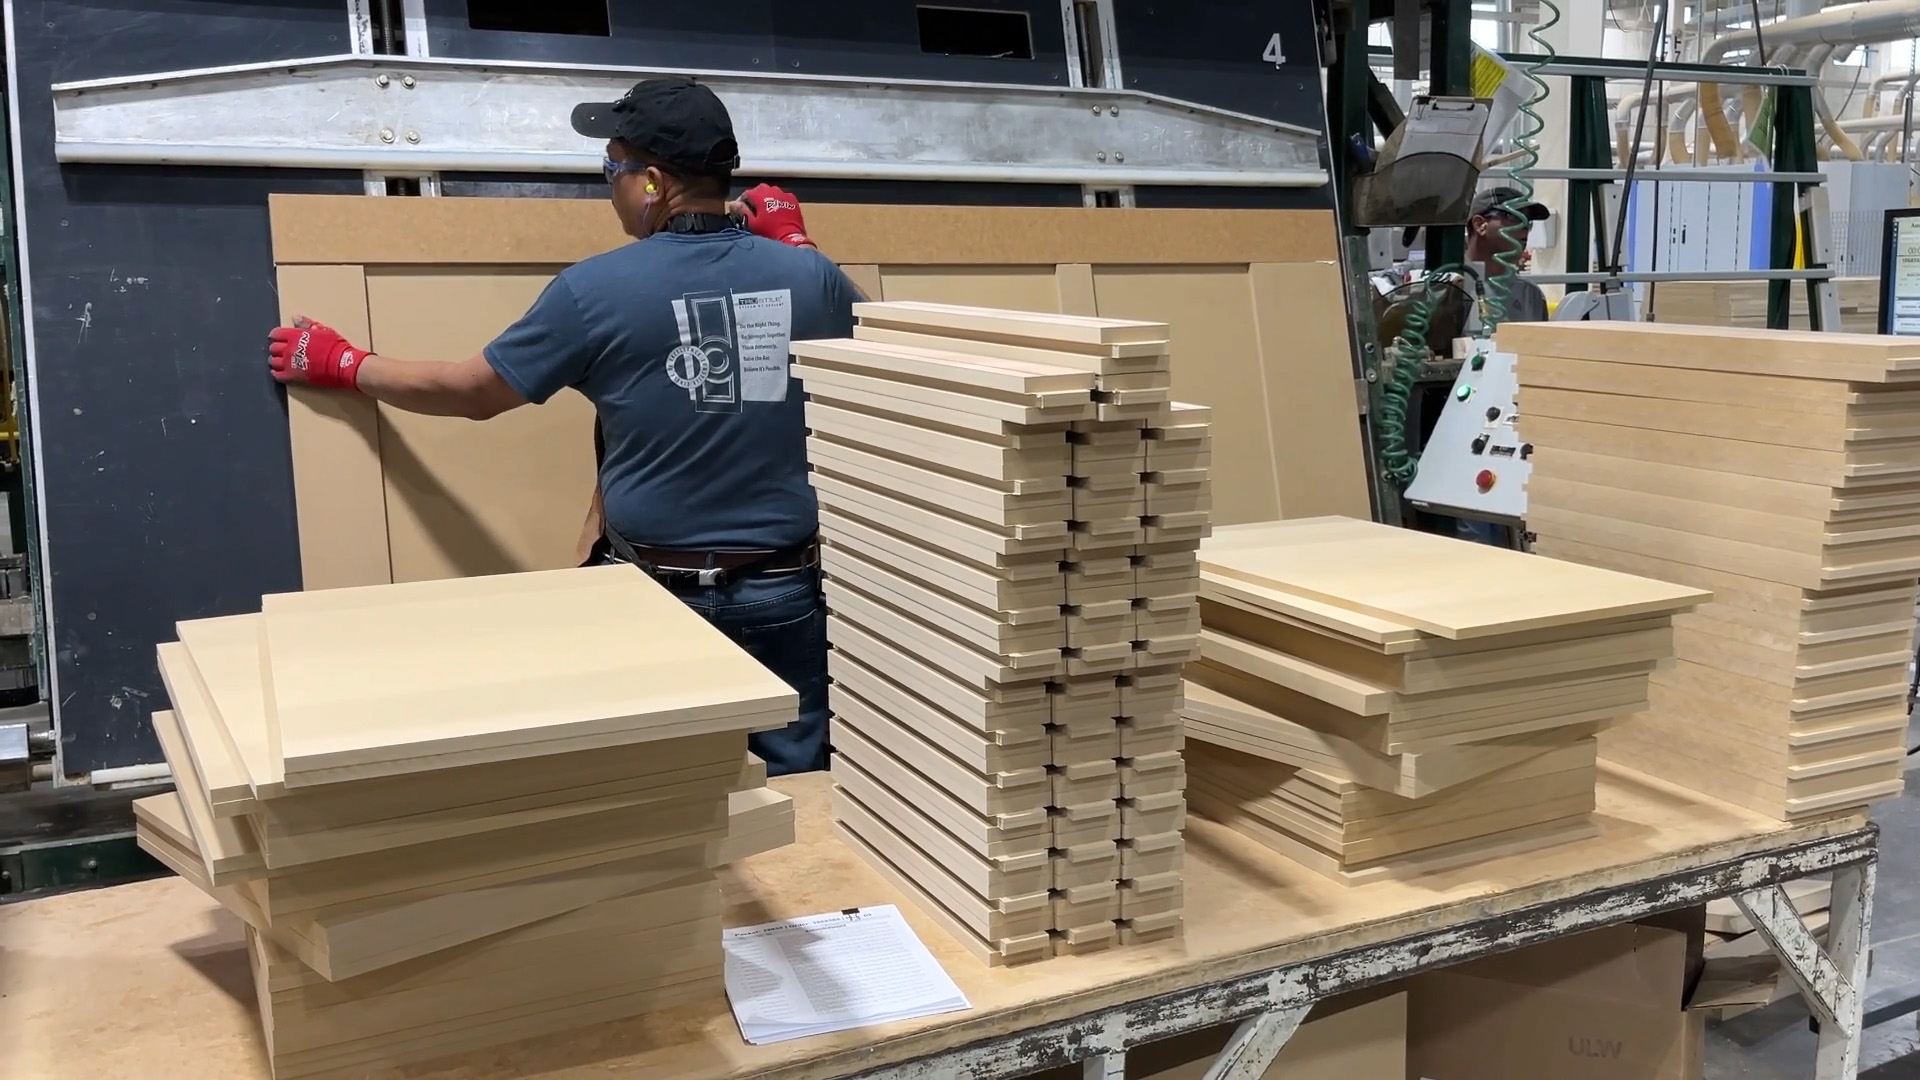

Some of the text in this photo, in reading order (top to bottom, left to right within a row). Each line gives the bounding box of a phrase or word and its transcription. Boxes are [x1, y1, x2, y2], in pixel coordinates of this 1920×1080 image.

[1262, 32, 1286, 65] 4
[755, 321, 767, 329] Right
[294, 331, 310, 371] NINJA
